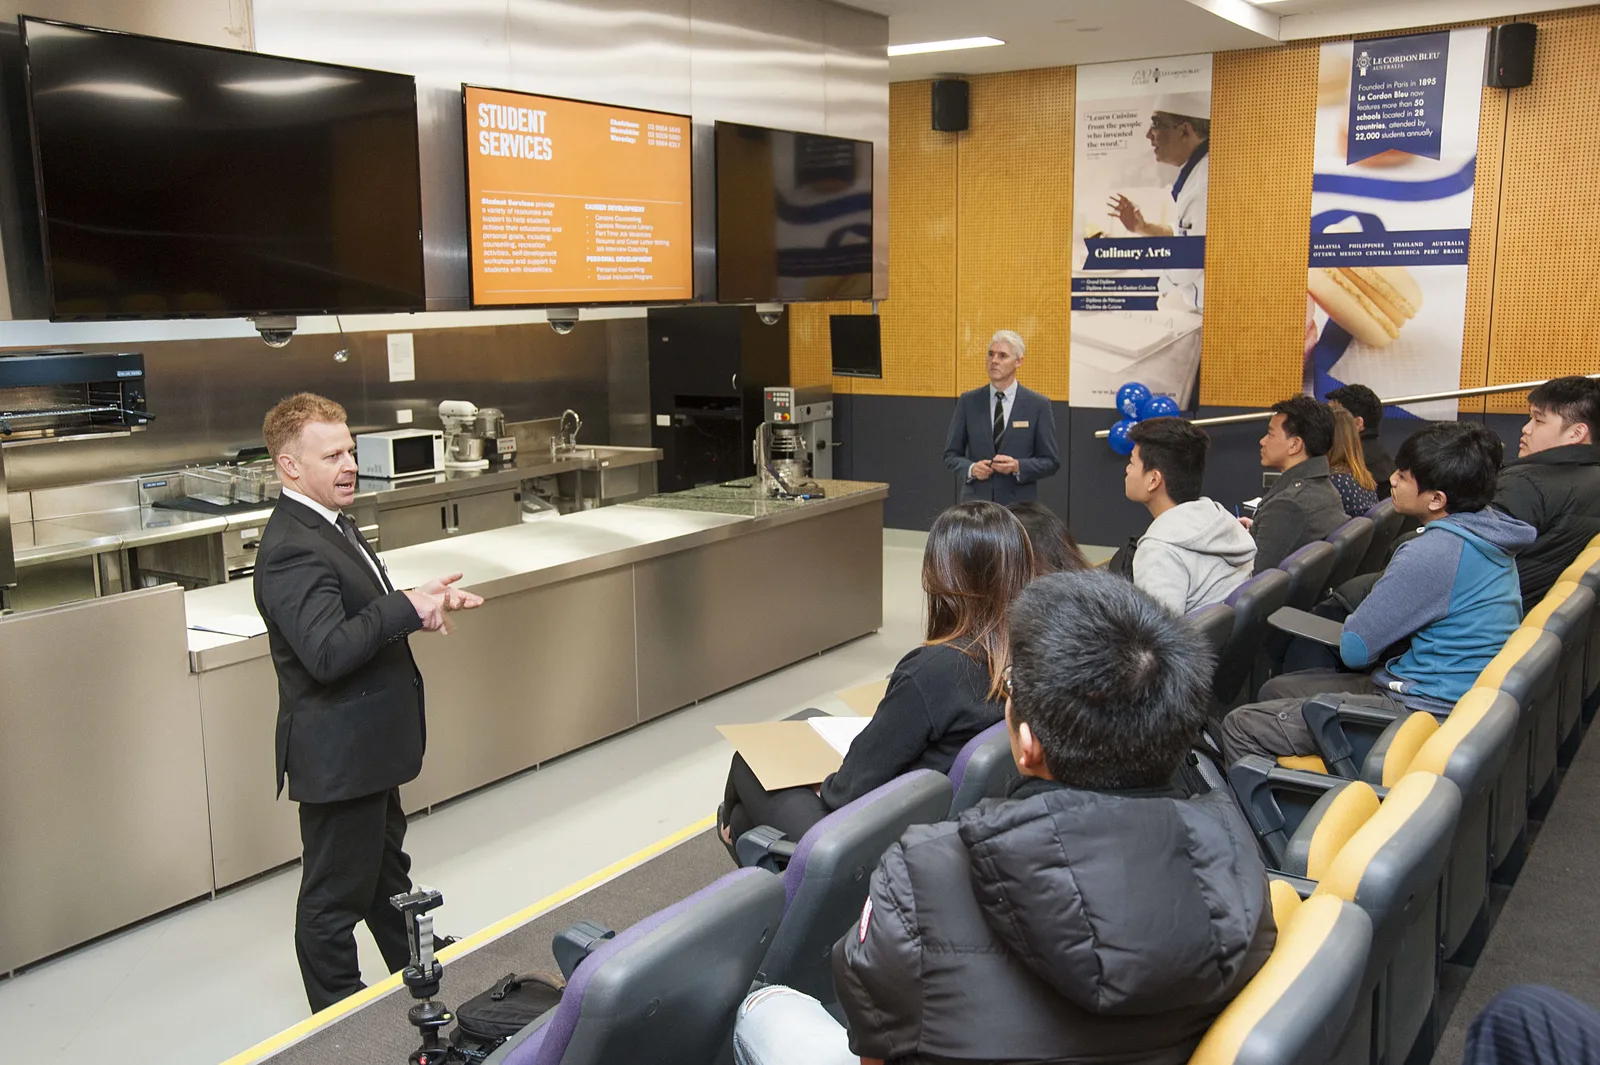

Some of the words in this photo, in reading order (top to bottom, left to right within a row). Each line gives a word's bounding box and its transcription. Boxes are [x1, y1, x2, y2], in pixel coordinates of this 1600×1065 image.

[1383, 55, 1418, 64] CORDON
[1419, 52, 1439, 60] BLEU
[478, 103, 547, 134] STUDENT
[1357, 112, 1380, 121] schools
[1383, 110, 1404, 119] located
[1119, 120, 1141, 129] people
[1355, 132, 1380, 140] 22,000
[1407, 128, 1433, 137] annually
[479, 131, 552, 160] SERVICES
[1094, 247, 1143, 260] Culinary
[1145, 247, 1171, 257] Arts
